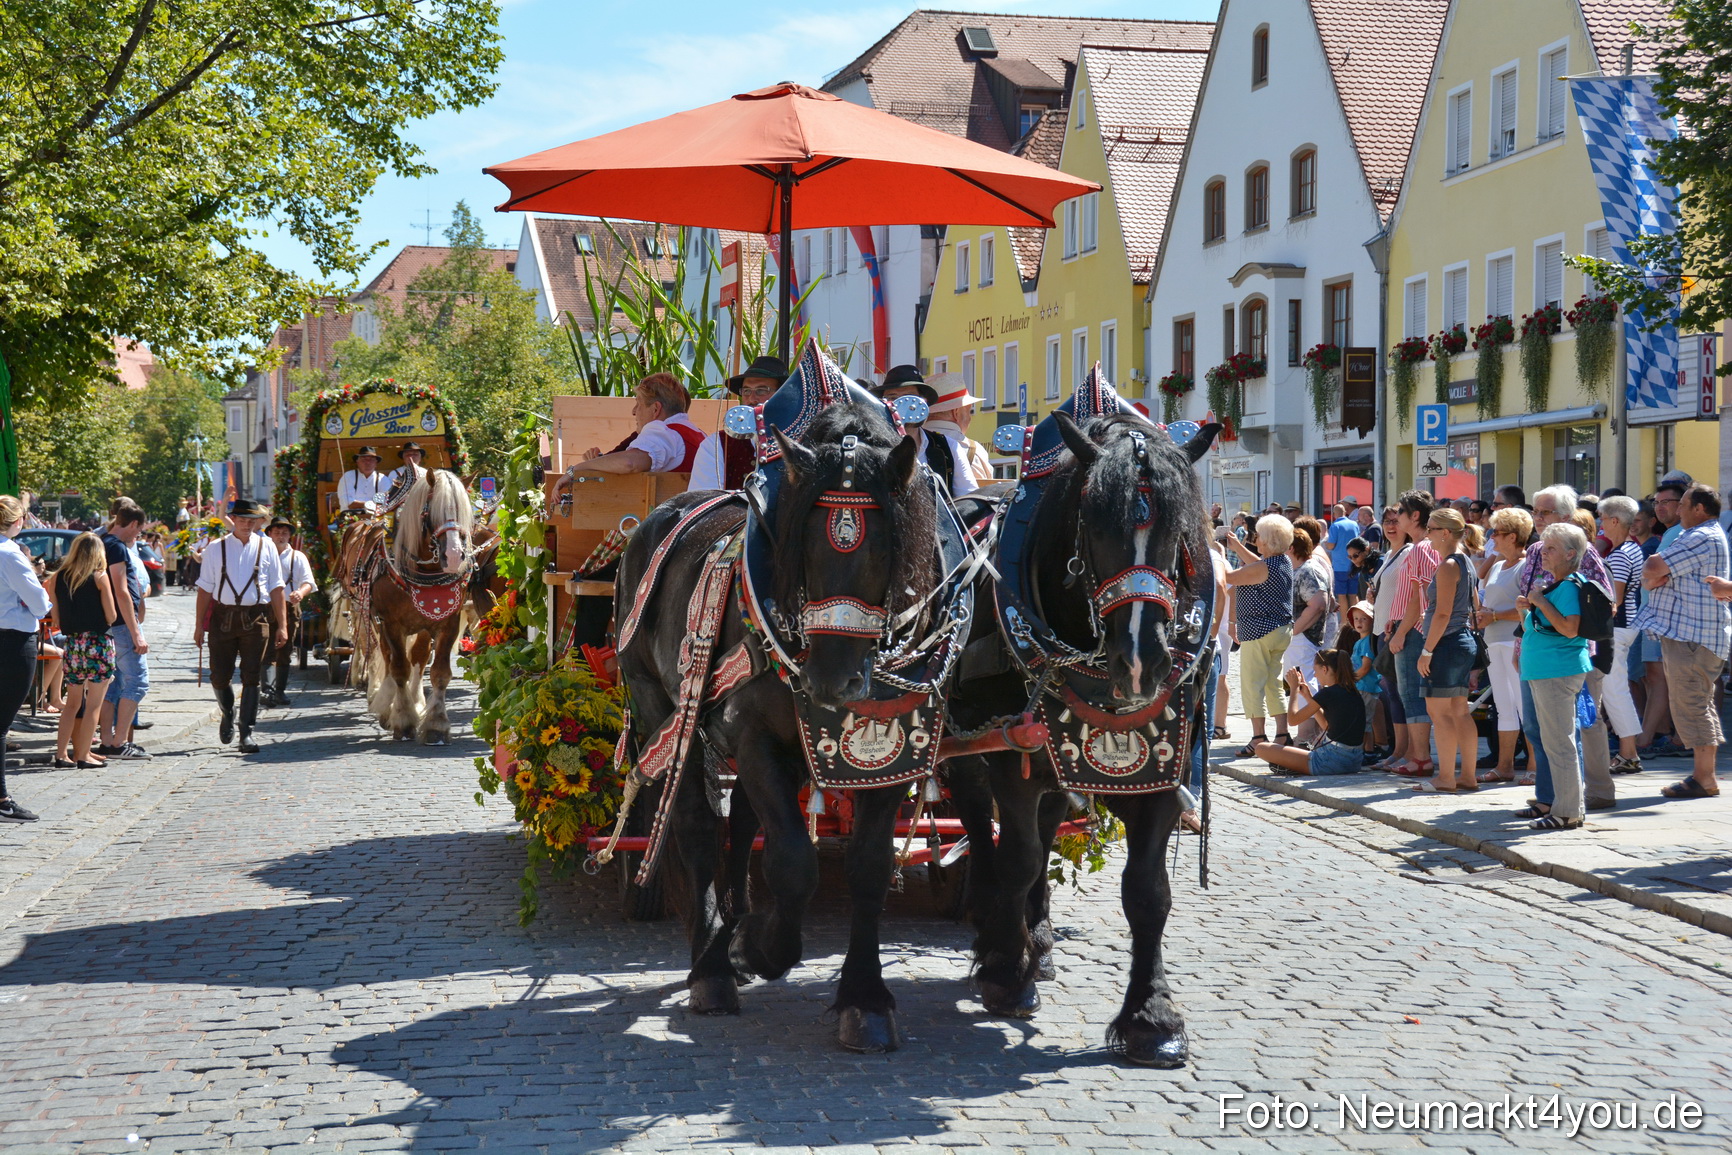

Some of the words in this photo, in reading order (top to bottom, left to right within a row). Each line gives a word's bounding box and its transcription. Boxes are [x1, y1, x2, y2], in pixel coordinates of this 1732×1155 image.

[969, 316, 994, 343] HOTEL
[1000, 311, 1030, 334] Lehmeier
[1702, 338, 1713, 413] KINO
[1449, 386, 1466, 399] WOLLE
[349, 402, 413, 436] Glossner
[384, 420, 415, 434] Bier
[1423, 410, 1441, 441] P
